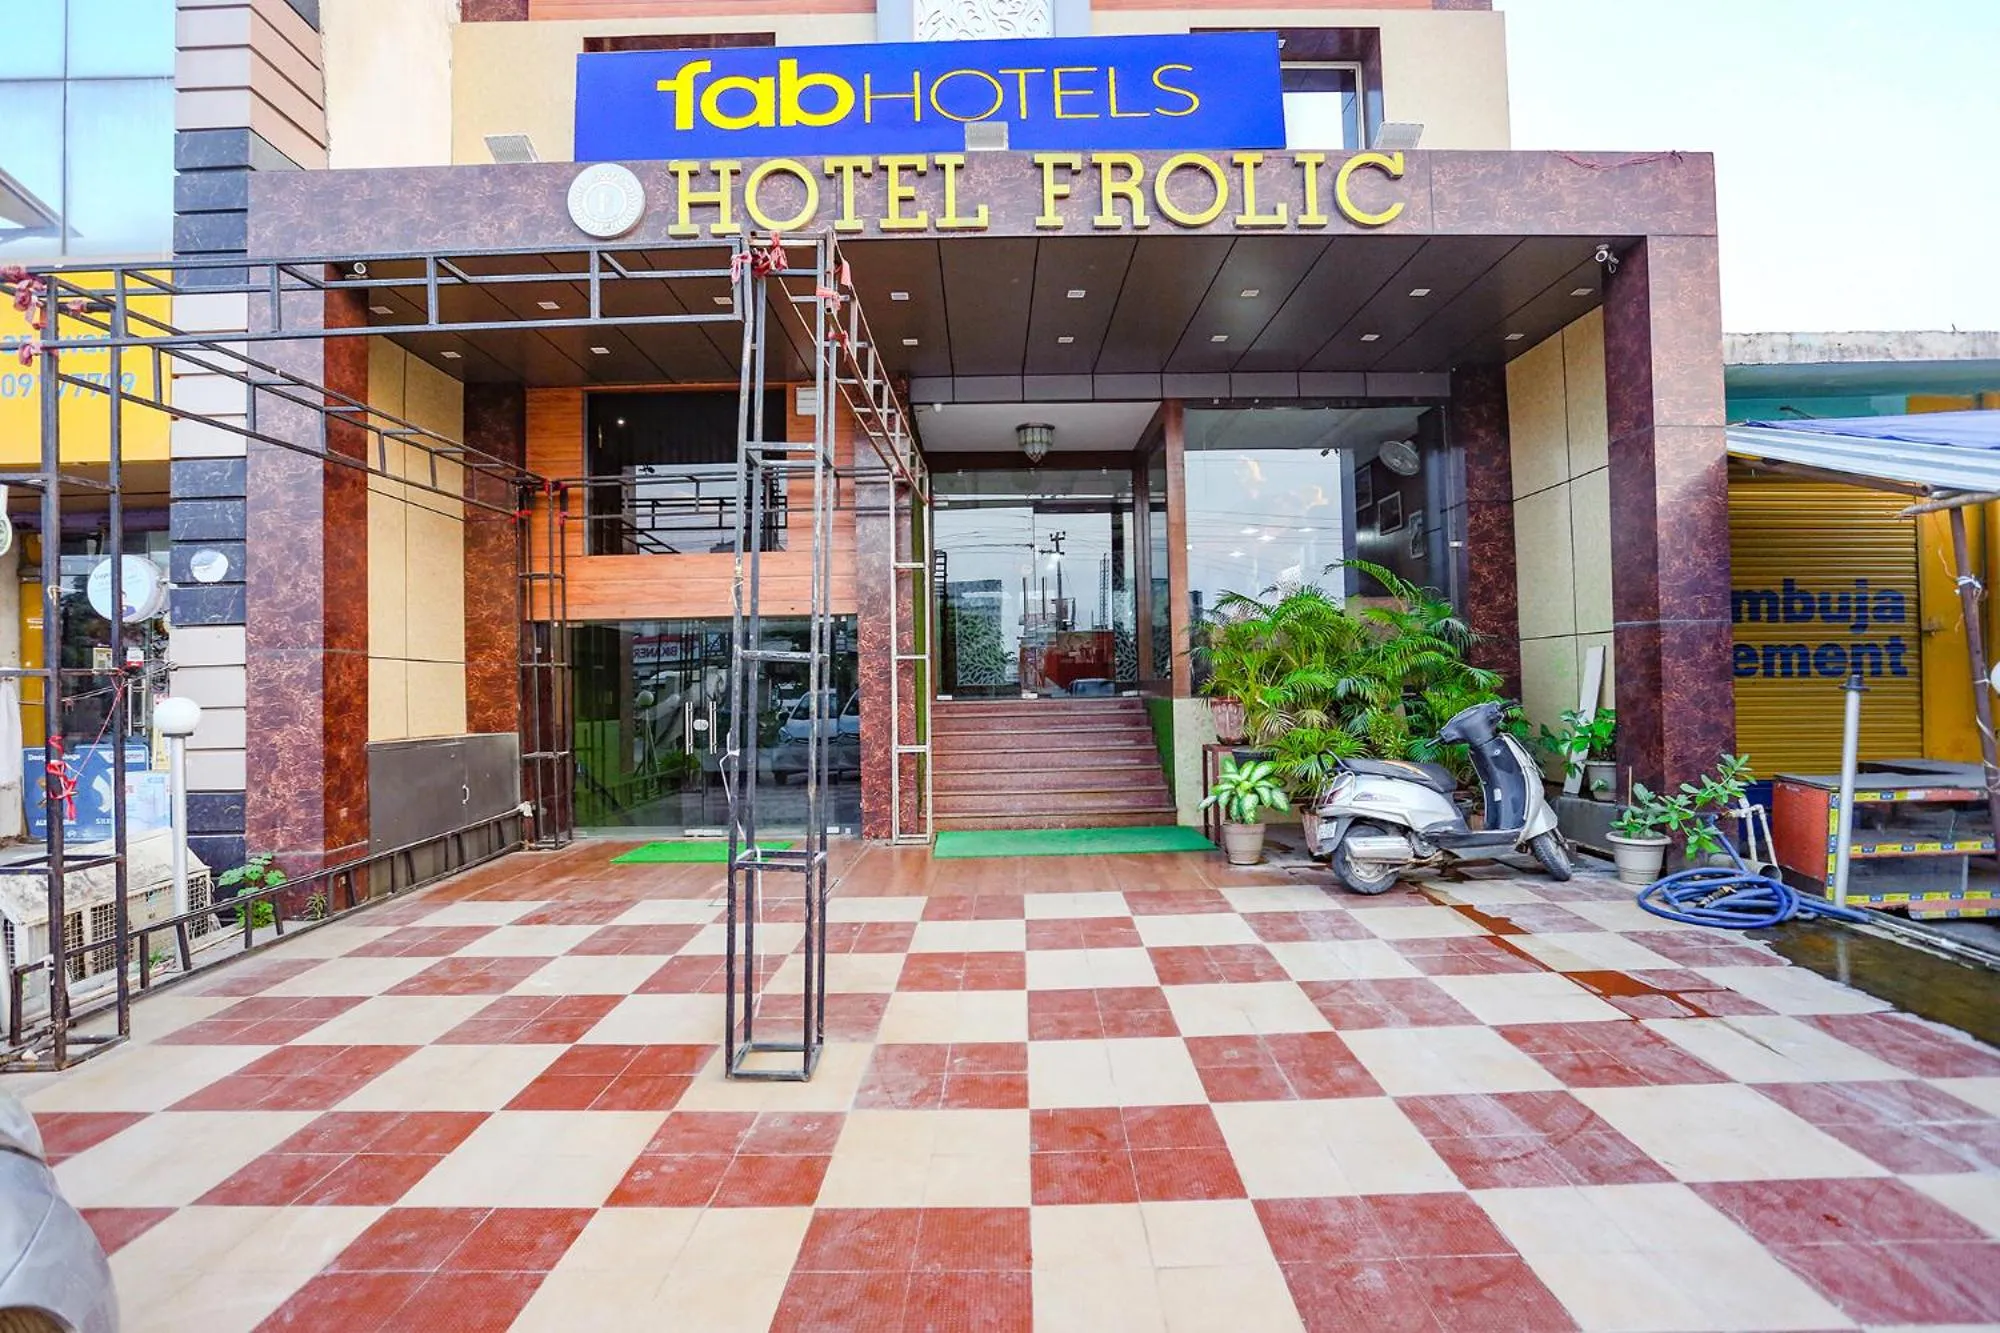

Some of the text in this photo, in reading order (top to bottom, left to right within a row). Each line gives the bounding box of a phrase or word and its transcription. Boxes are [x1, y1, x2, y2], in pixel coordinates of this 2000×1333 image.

[667, 151, 1406, 238] HOTEL FROLIC
[1730, 578, 1906, 634] mbuja
[1732, 635, 1909, 678] ement
